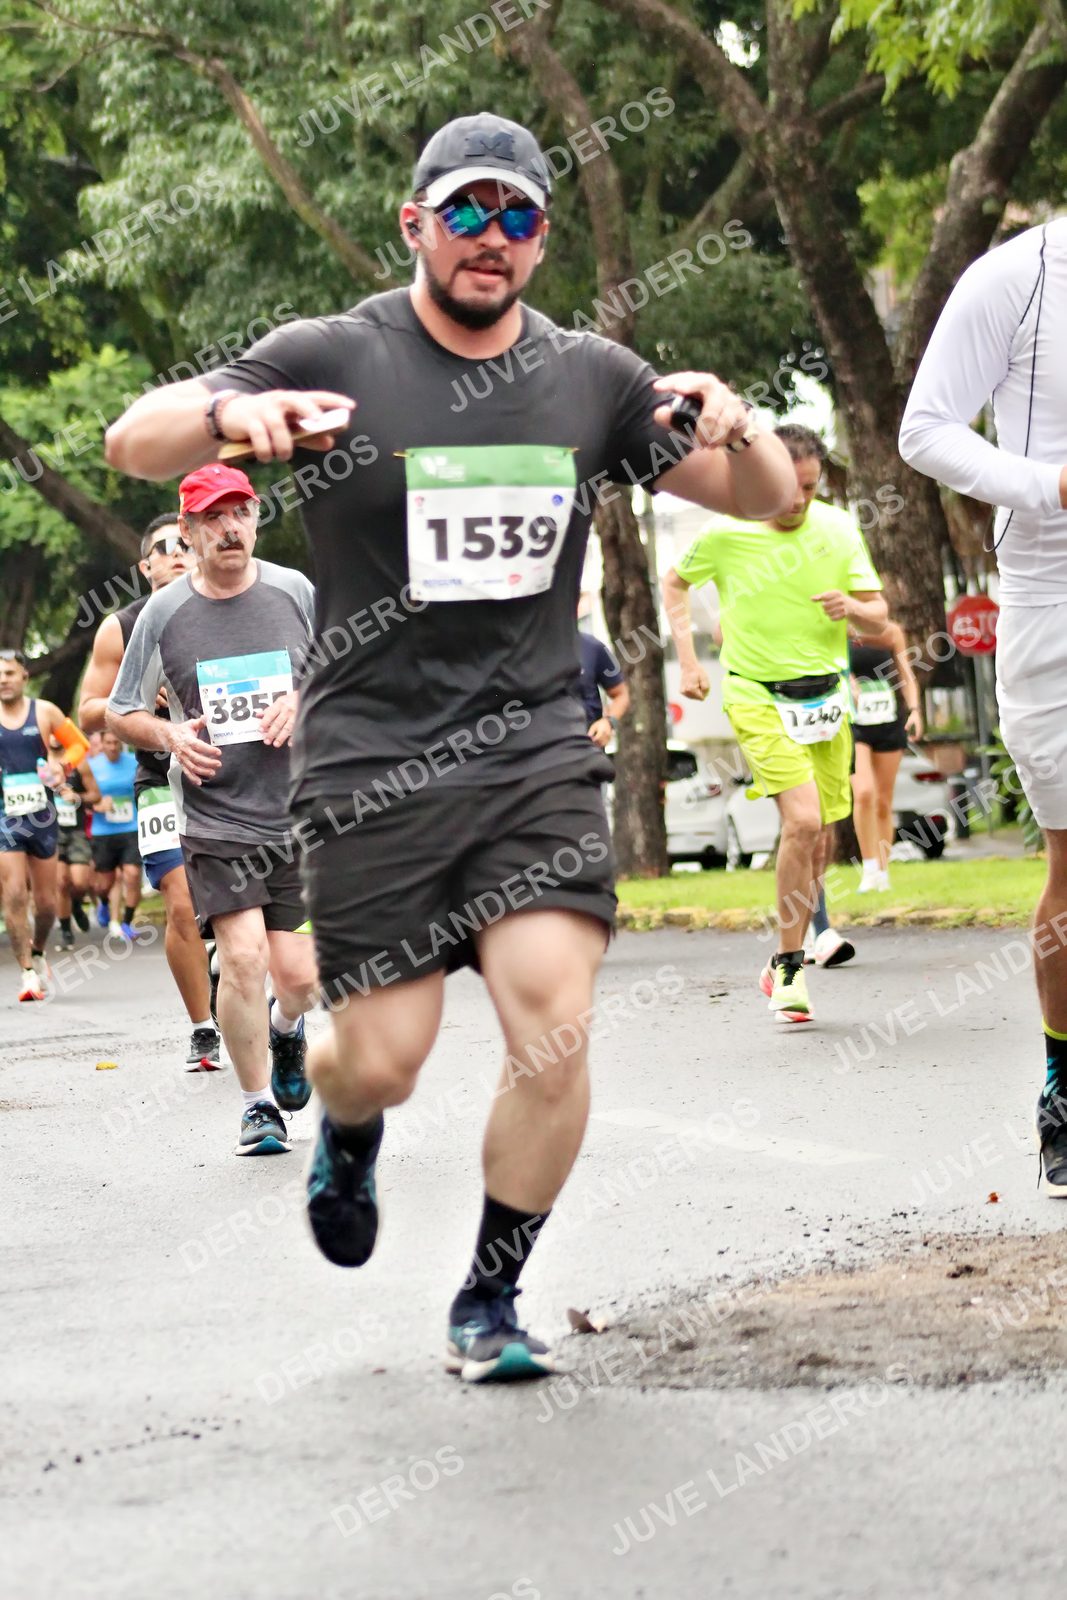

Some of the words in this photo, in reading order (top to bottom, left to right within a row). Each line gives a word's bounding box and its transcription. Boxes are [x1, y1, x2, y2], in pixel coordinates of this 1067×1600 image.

[426, 515, 558, 562] 1539
[786, 705, 842, 727] 1240
[7, 792, 44, 807] 5942
